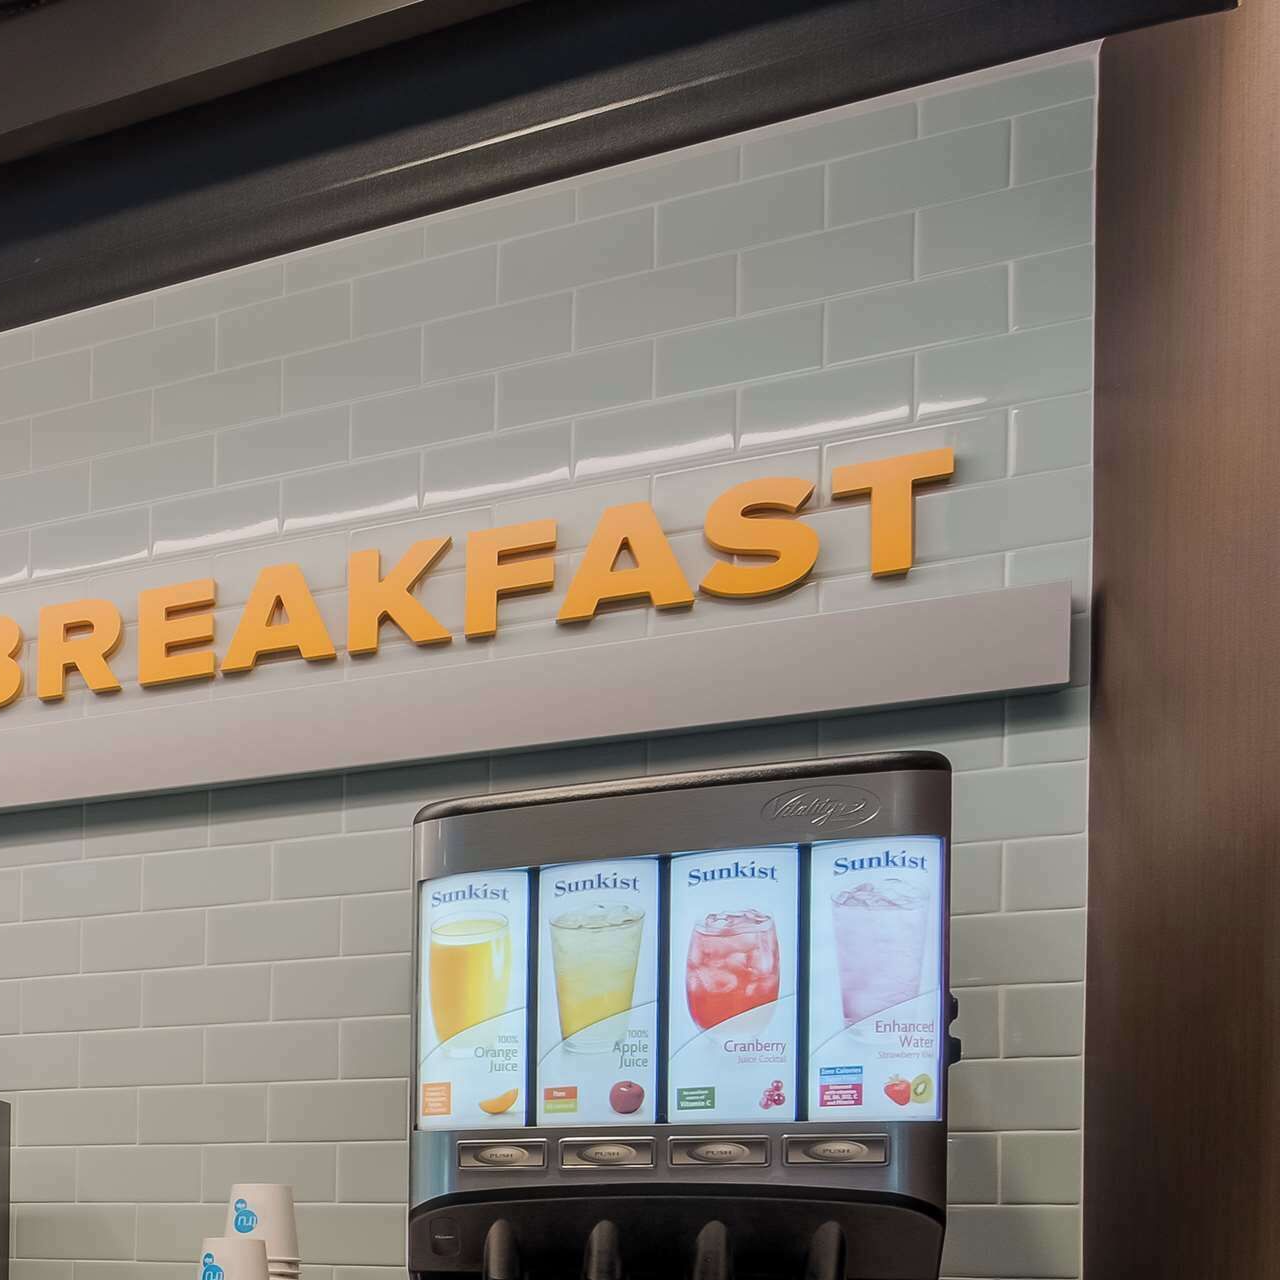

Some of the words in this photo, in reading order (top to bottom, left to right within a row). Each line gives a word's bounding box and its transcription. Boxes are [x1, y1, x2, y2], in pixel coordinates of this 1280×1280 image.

[833, 850, 928, 876] Sunkist
[688, 860, 779, 888] Sunkist
[553, 872, 640, 897] Sunkist
[431, 883, 510, 908] Sunkist
[875, 1020, 935, 1033] Enhanced
[612, 1040, 649, 1056] Apple
[724, 1039, 787, 1055] Cranberry
[899, 1035, 934, 1049] Water
[474, 1046, 518, 1060] Orange
[488, 1060, 518, 1073] Juice
[619, 1056, 649, 1069] Juice
